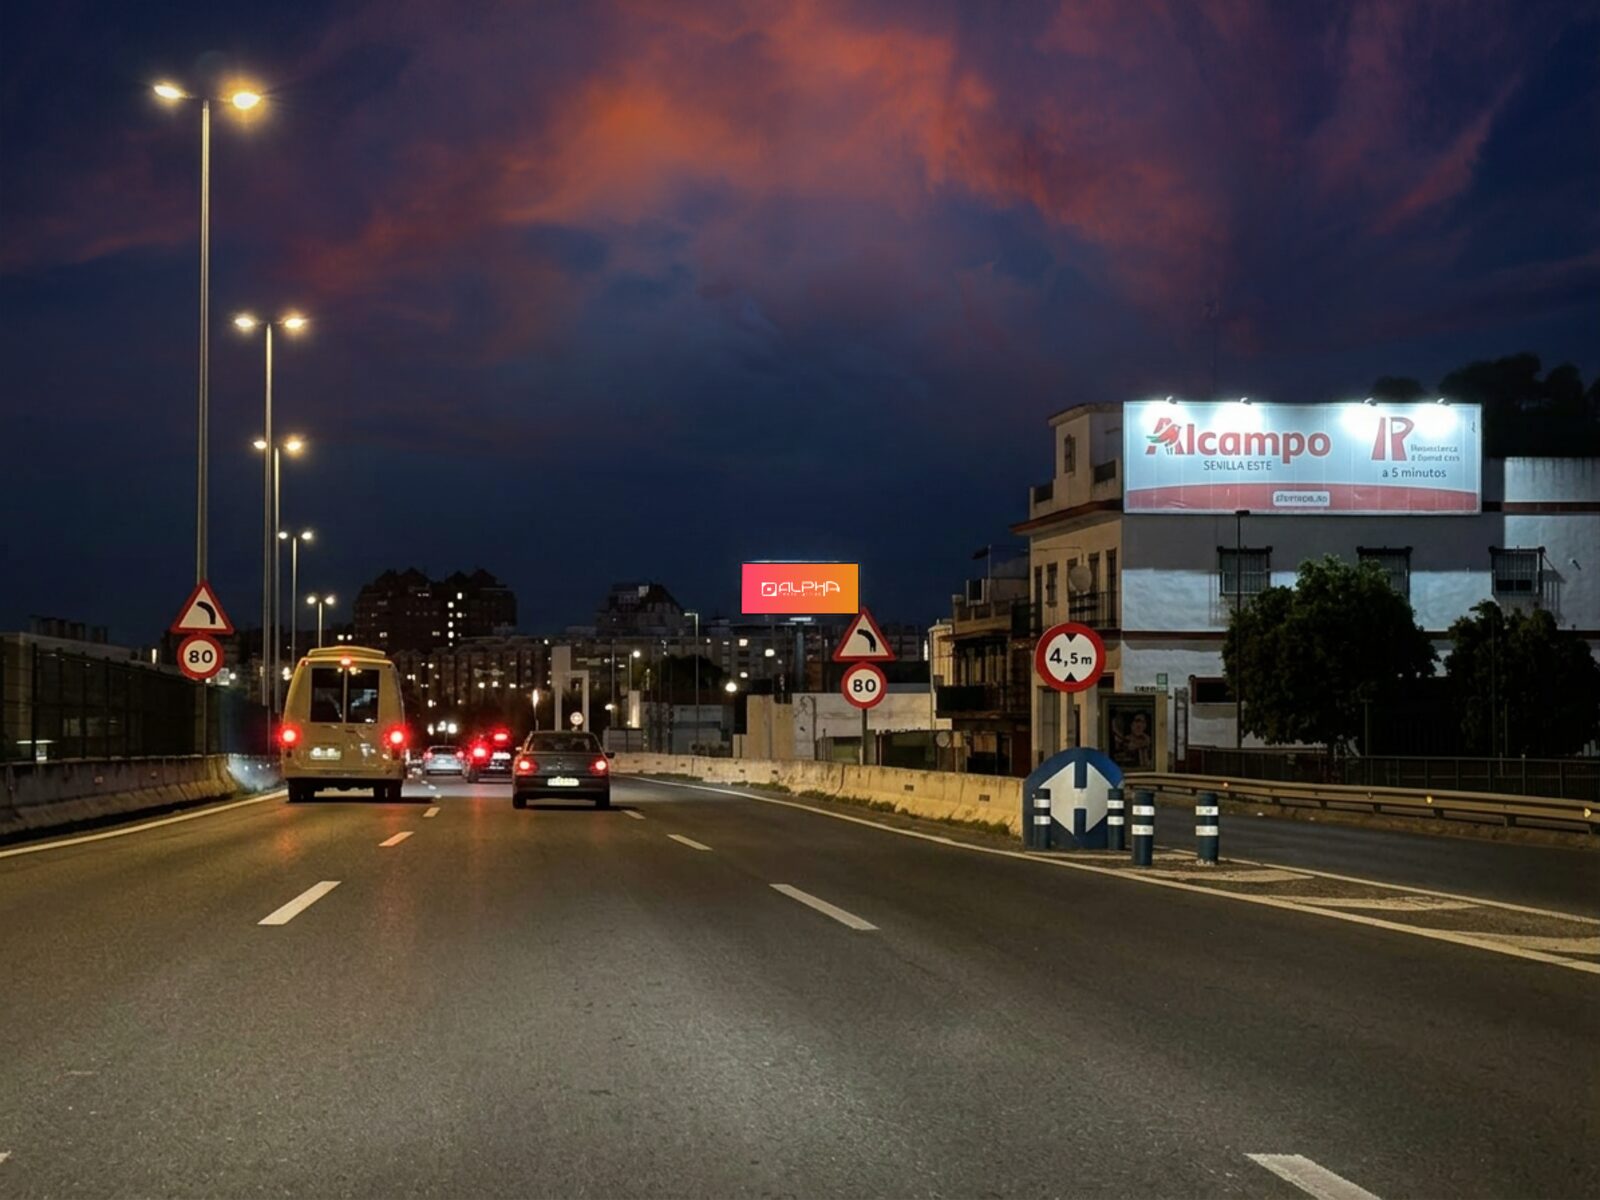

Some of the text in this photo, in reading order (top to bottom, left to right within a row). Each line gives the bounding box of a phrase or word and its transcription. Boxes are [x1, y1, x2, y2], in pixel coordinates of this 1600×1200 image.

[1145, 417, 1331, 464] Alcampo
[1247, 460, 1272, 471] ESTE
[1382, 467, 1447, 478] a 5 minutos
[778, 580, 840, 597] ALPHA
[189, 650, 213, 664] 80
[853, 679, 876, 693] 80
